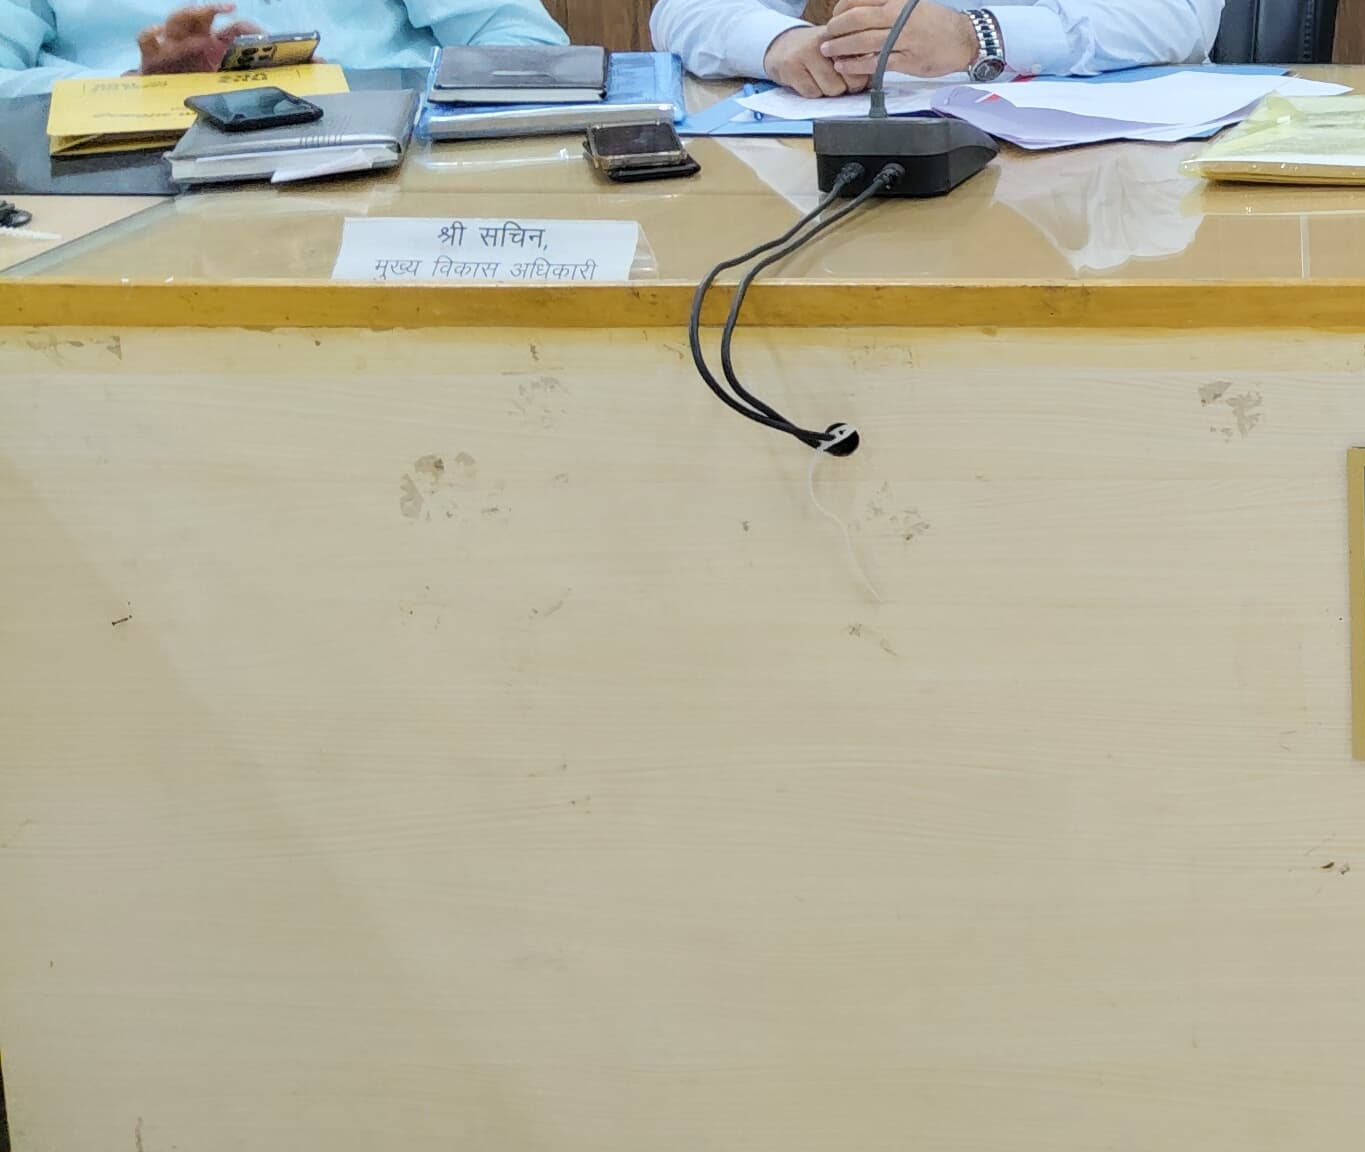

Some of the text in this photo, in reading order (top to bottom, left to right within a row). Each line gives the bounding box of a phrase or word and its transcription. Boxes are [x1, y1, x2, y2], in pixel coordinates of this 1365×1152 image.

[438, 220, 549, 251] श्री सचिन,
[375, 256, 599, 280] मुख्य विकास अधिकारी
